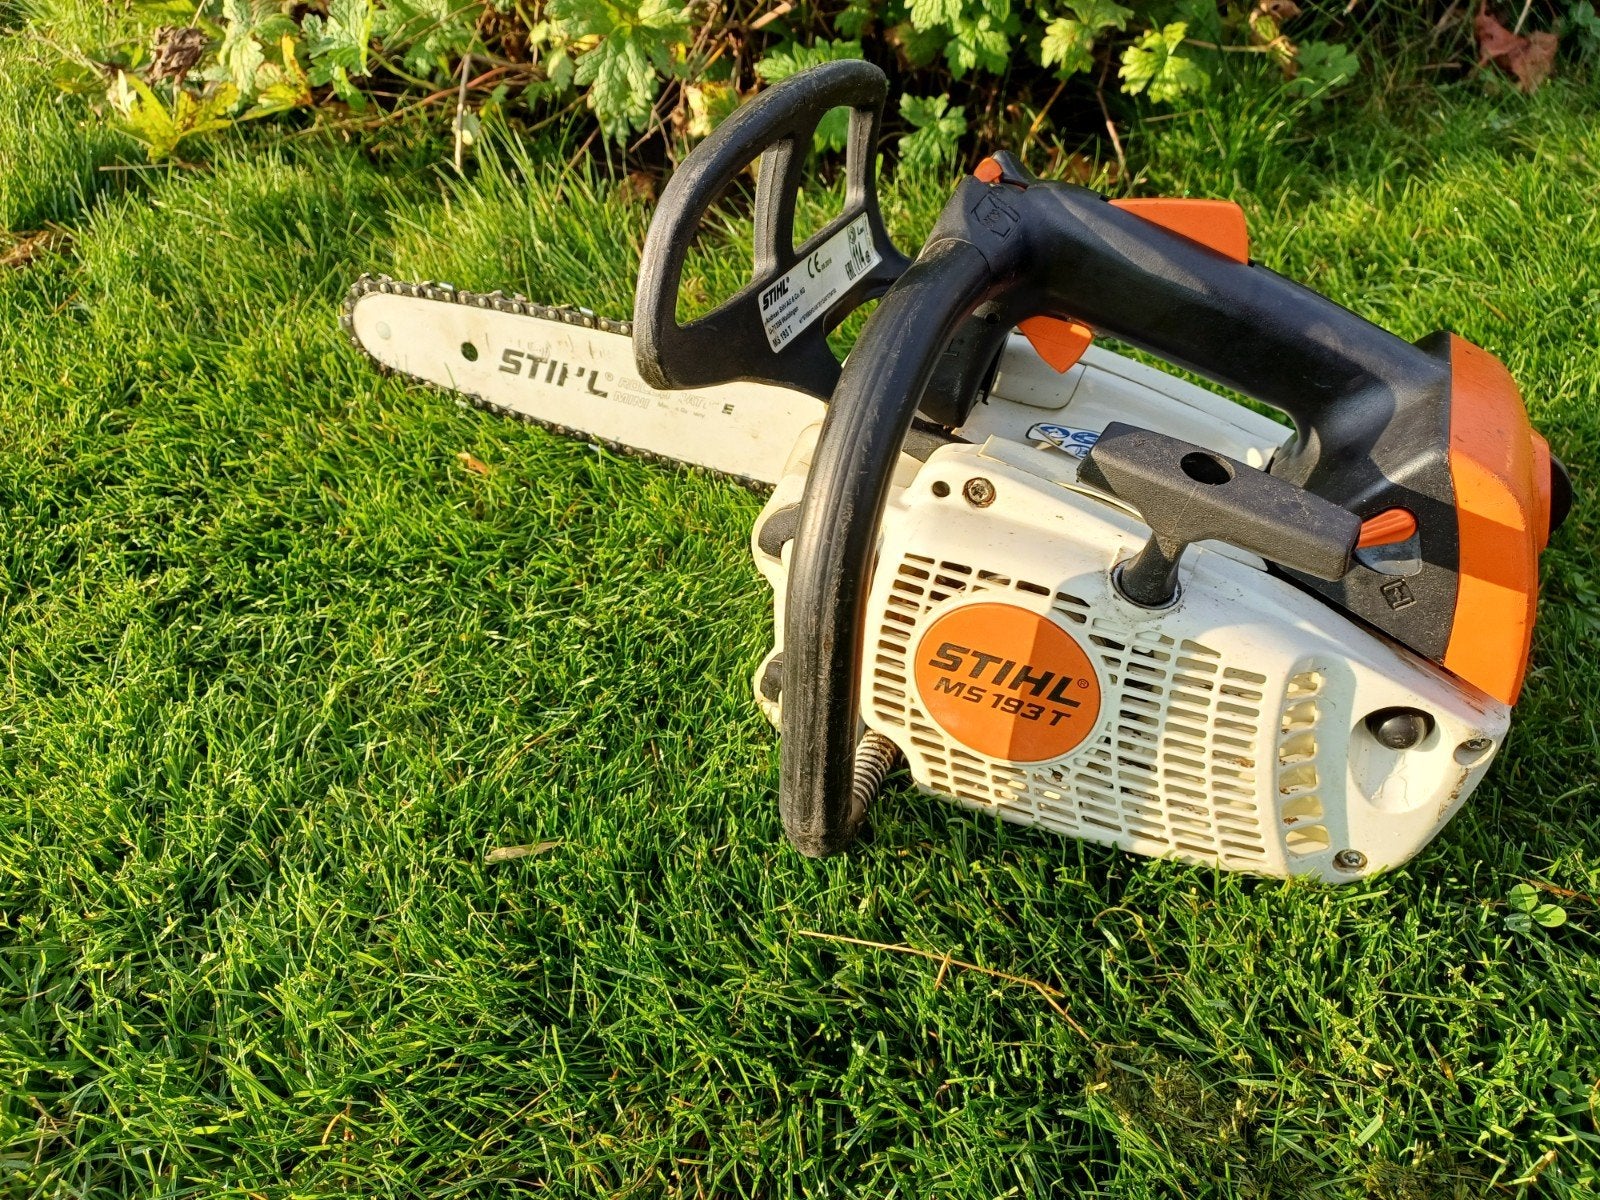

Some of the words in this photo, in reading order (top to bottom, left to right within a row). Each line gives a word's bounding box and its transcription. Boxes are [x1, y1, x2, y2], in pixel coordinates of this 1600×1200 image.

[612, 390, 651, 410] MINI
[721, 402, 735, 415] E
[934, 676, 988, 703] MS
[991, 693, 1045, 721] 193
[1049, 709, 1072, 727] T
